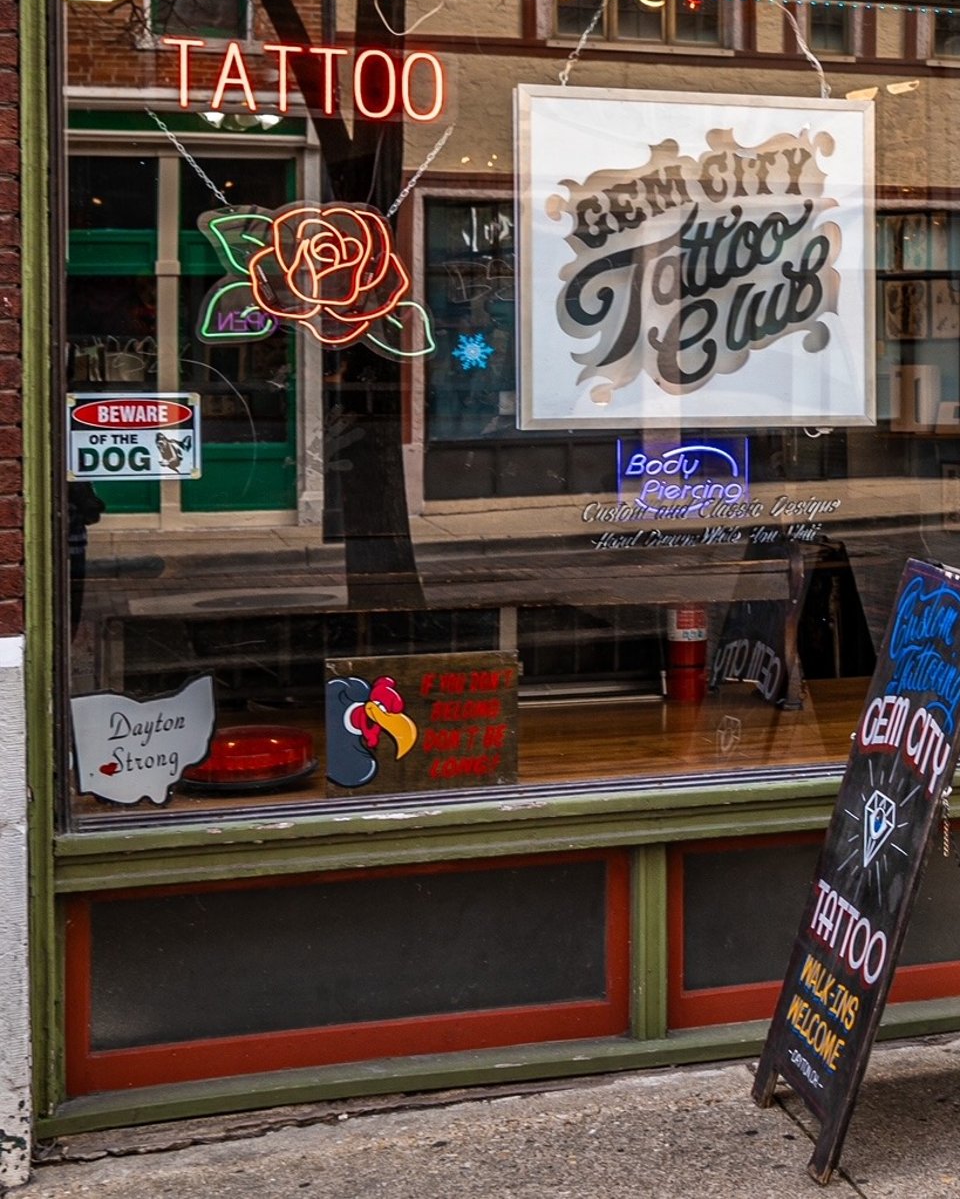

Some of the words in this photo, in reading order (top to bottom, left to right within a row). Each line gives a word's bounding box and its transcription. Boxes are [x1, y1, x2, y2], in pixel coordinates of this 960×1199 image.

[163, 37, 445, 122] TATTOO
[574, 164, 694, 248] GEM
[696, 148, 812, 202] CITY
[564, 199, 814, 368] Tattoo
[648, 234, 831, 384] Club
[97, 405, 169, 423] BEWARE
[89, 435, 107, 445] OF
[111, 434, 138, 445] THE
[78, 446, 151, 473] DOG
[625, 454, 700, 479] Body
[641, 479, 743, 504] Piercing
[581, 501, 647, 522] Custom
[698, 497, 764, 519] Classic
[769, 495, 841, 521] Designs
[591, 530, 644, 550] Hand
[421, 672, 435, 696] IF
[440, 672, 466, 695] YOU
[431, 698, 502, 721] BELONG
[107, 711, 185, 747] Dayton
[482, 723, 508, 749] BE
[861, 695, 910, 749] GEM
[905, 707, 951, 795] CITY
[110, 746, 180, 776] Strong
[810, 878, 888, 985] TATTOO
[800, 954, 860, 1031] WALK-INS
[786, 994, 847, 1072] WELCOME
